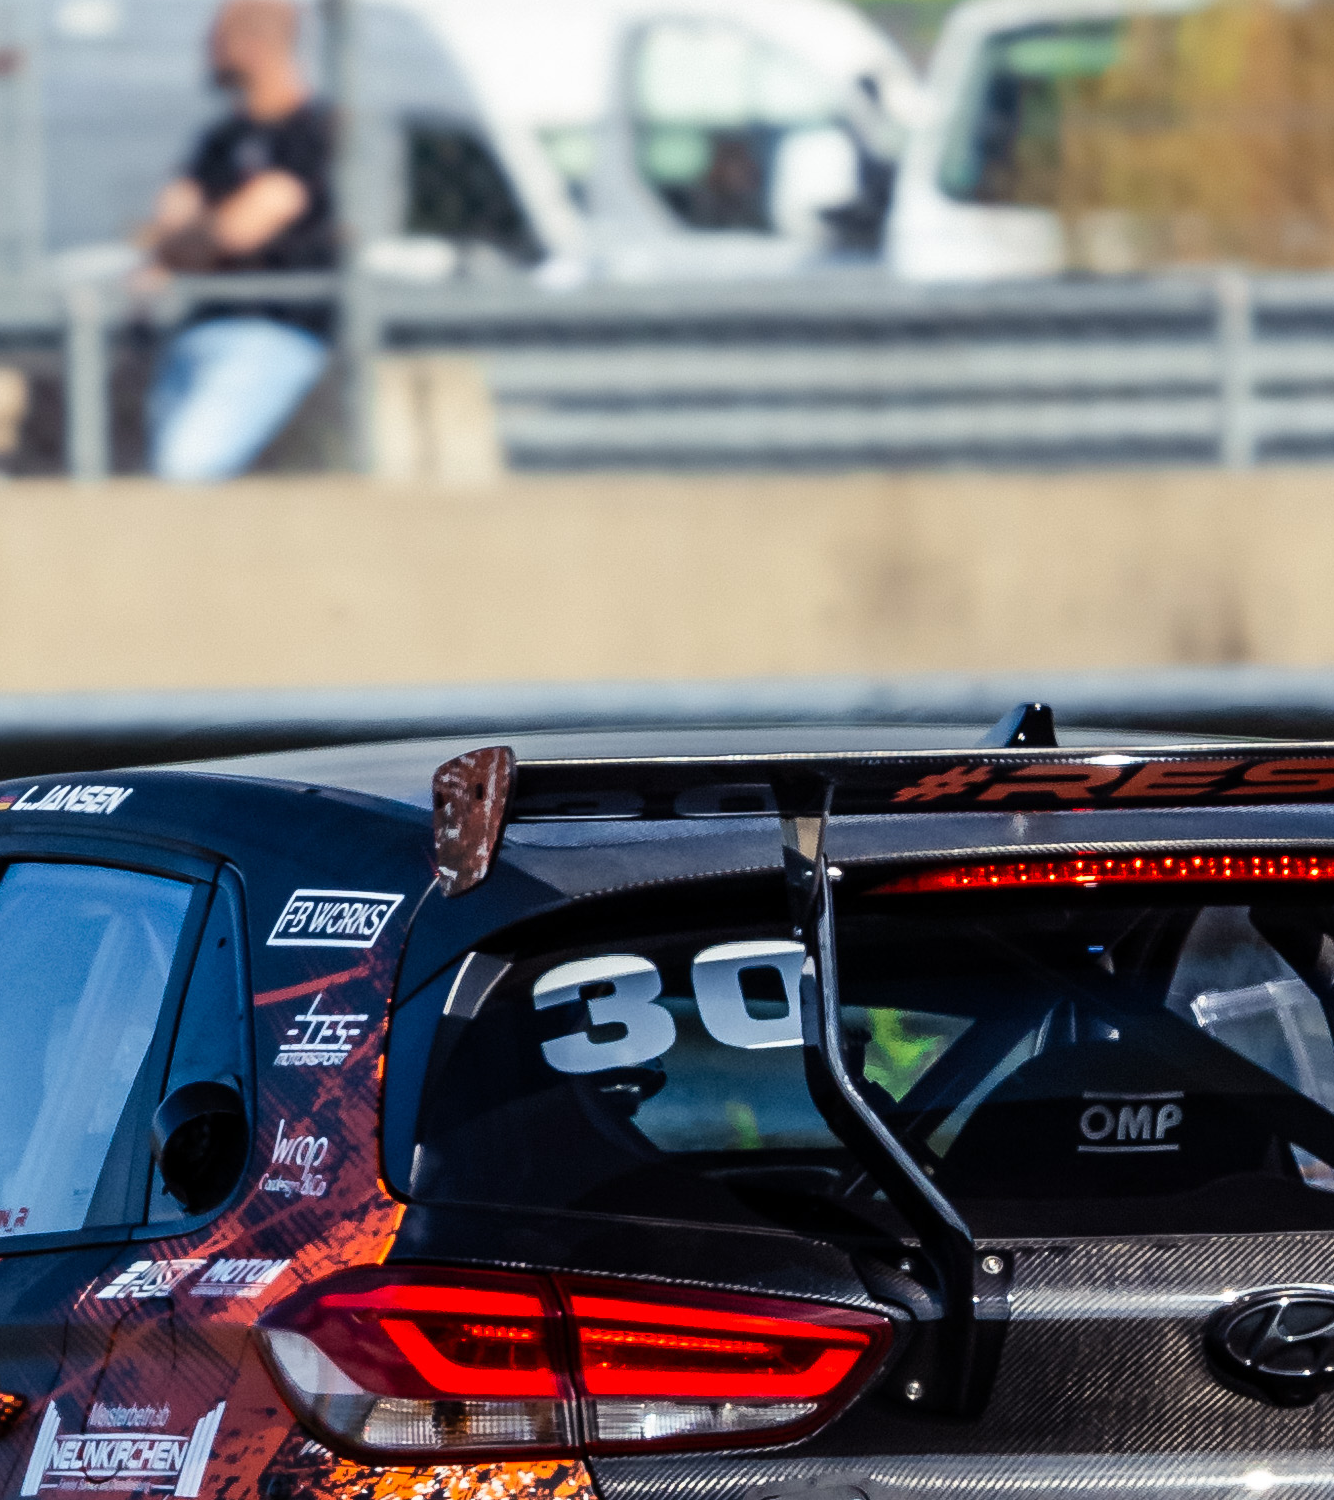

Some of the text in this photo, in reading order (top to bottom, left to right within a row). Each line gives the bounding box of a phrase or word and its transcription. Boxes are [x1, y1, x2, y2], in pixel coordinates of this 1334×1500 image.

[308, 902, 388, 935] WORKS
[533, 940, 806, 1075] 30
[1080, 1103, 1184, 1140] OMP
